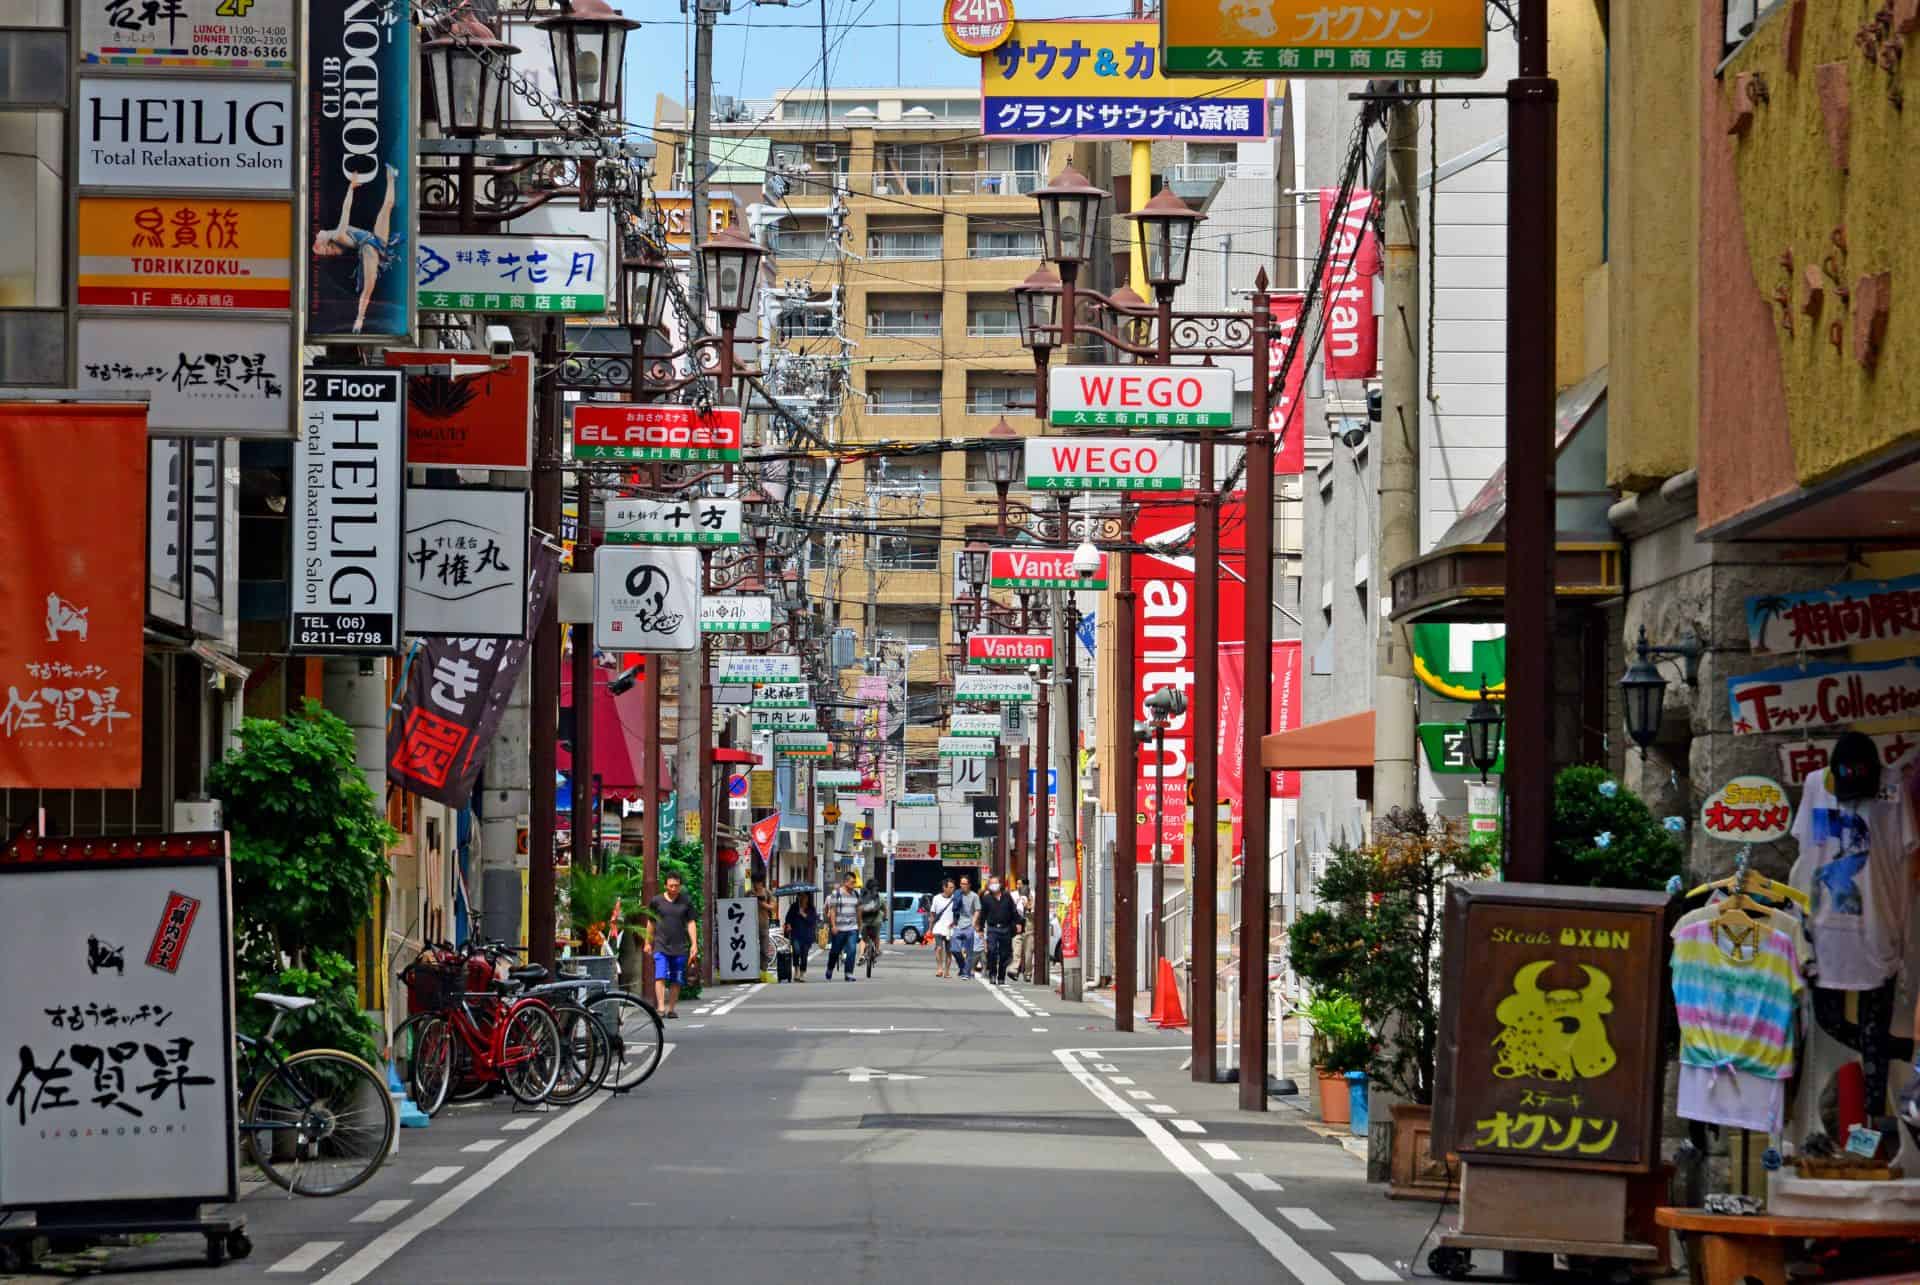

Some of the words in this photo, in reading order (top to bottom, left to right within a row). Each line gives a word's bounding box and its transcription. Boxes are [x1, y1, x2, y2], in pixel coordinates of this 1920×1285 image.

[193, 25, 226, 34] LUNCH
[1291, 6, 1433, 42] オクソン
[193, 35, 230, 44] DINNER
[192, 45, 287, 58] 06-4708-6366
[993, 40, 1158, 80] サウナ&カ
[1207, 49, 1443, 69] 久左衛門商店街
[323, 56, 341, 119] CLUB
[89, 98, 285, 147] HEILIG
[997, 103, 1250, 131] グランドサウナ心斎橋
[91, 150, 135, 166] Total
[142, 151, 230, 169] Relaxation
[236, 152, 283, 169] Salon
[131, 258, 239, 275] TORIKIZOKU
[456, 251, 491, 265] 料亭
[131, 291, 153, 305] 1F
[304, 378, 316, 397] 2
[327, 378, 386, 398] Floor
[1080, 376, 1202, 408] WEGO
[1074, 412, 1209, 426] 久左衛門商店街
[307, 410, 325, 458] Total
[581, 426, 617, 441] EL
[595, 447, 718, 459] 久左衛門商店街
[1052, 447, 1157, 473] WEGO
[1046, 478, 1162, 489] 久左衛門商店街
[306, 463, 324, 552] Relaxation
[329, 410, 379, 607] HEILIG
[664, 505, 726, 530] 十方
[434, 536, 477, 550] すし屋台
[1010, 554, 1077, 577] Vanta
[306, 558, 323, 605] Salon
[302, 616, 330, 630] TEL
[336, 615, 366, 631] (06)
[301, 630, 382, 645] 6211-6798
[983, 639, 1045, 657] Vantan
[1705, 801, 1789, 832] オススメ!
[728, 903, 749, 972] らーめん
[1491, 928, 1551, 945] Steak
[44, 1003, 174, 1031] すもうキッチン
[7, 1037, 215, 1127] 佐賀昇
[1520, 1089, 1581, 1109] ステーキ
[1476, 1112, 1619, 1153] オクソン
